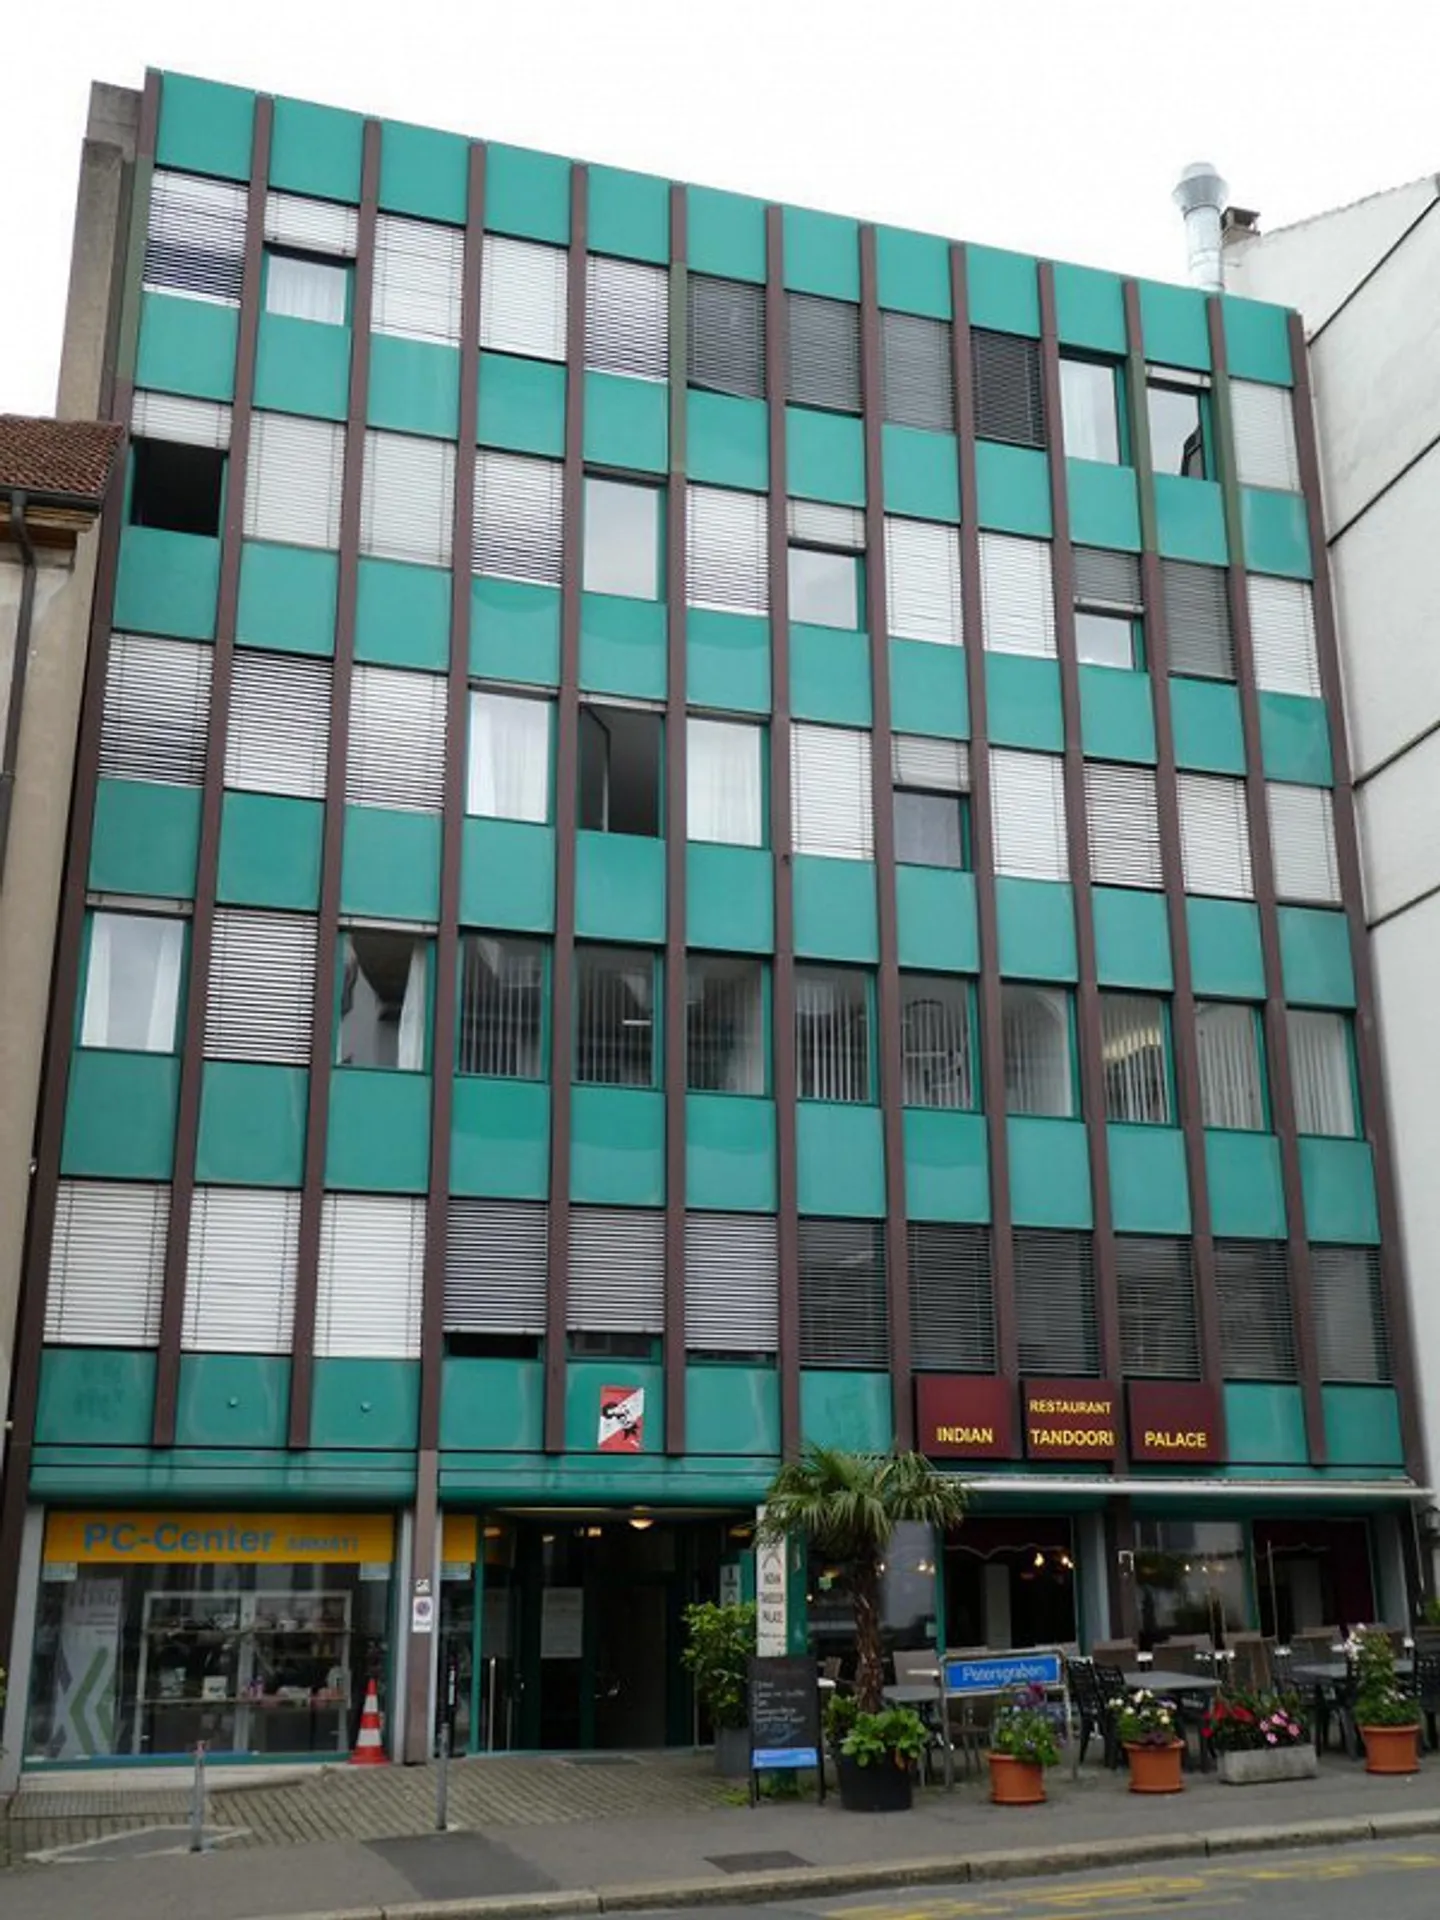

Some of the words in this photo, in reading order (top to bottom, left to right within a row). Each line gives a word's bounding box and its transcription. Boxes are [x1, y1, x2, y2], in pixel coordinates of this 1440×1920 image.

[1029, 1398, 1112, 1414] RESTAURANT
[936, 1426, 993, 1443] INDIAN
[1030, 1428, 1114, 1446] TANDOORI
[1145, 1431, 1207, 1448] PALACE
[84, 1521, 276, 1554] PC-Center
